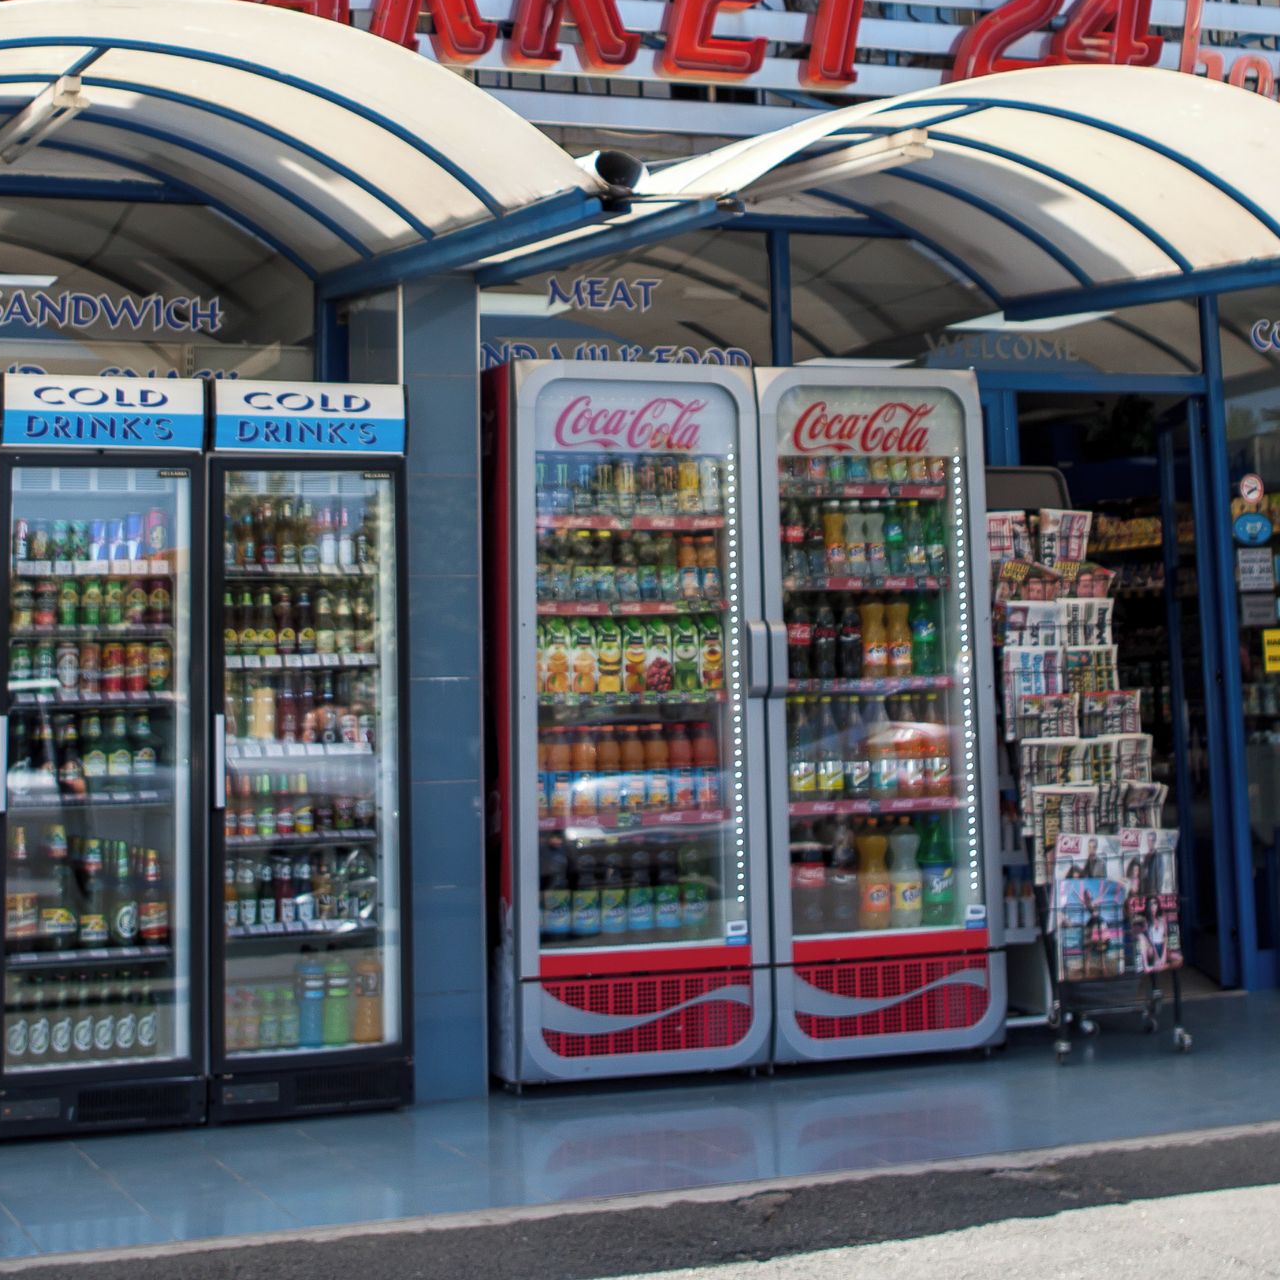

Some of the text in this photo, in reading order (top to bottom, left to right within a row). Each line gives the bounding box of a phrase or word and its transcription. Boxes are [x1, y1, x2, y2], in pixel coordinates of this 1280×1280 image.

[547, 275, 664, 313] MEAT
[922, 331, 1080, 361] WELCOME
[32, 386, 169, 407] COLD
[243, 391, 371, 413] COLD
[25, 414, 174, 441] DRINK'S
[236, 418, 379, 446] DRINK'S
[554, 395, 710, 450] Coca-Cola
[792, 401, 936, 453] Coca-Cola
